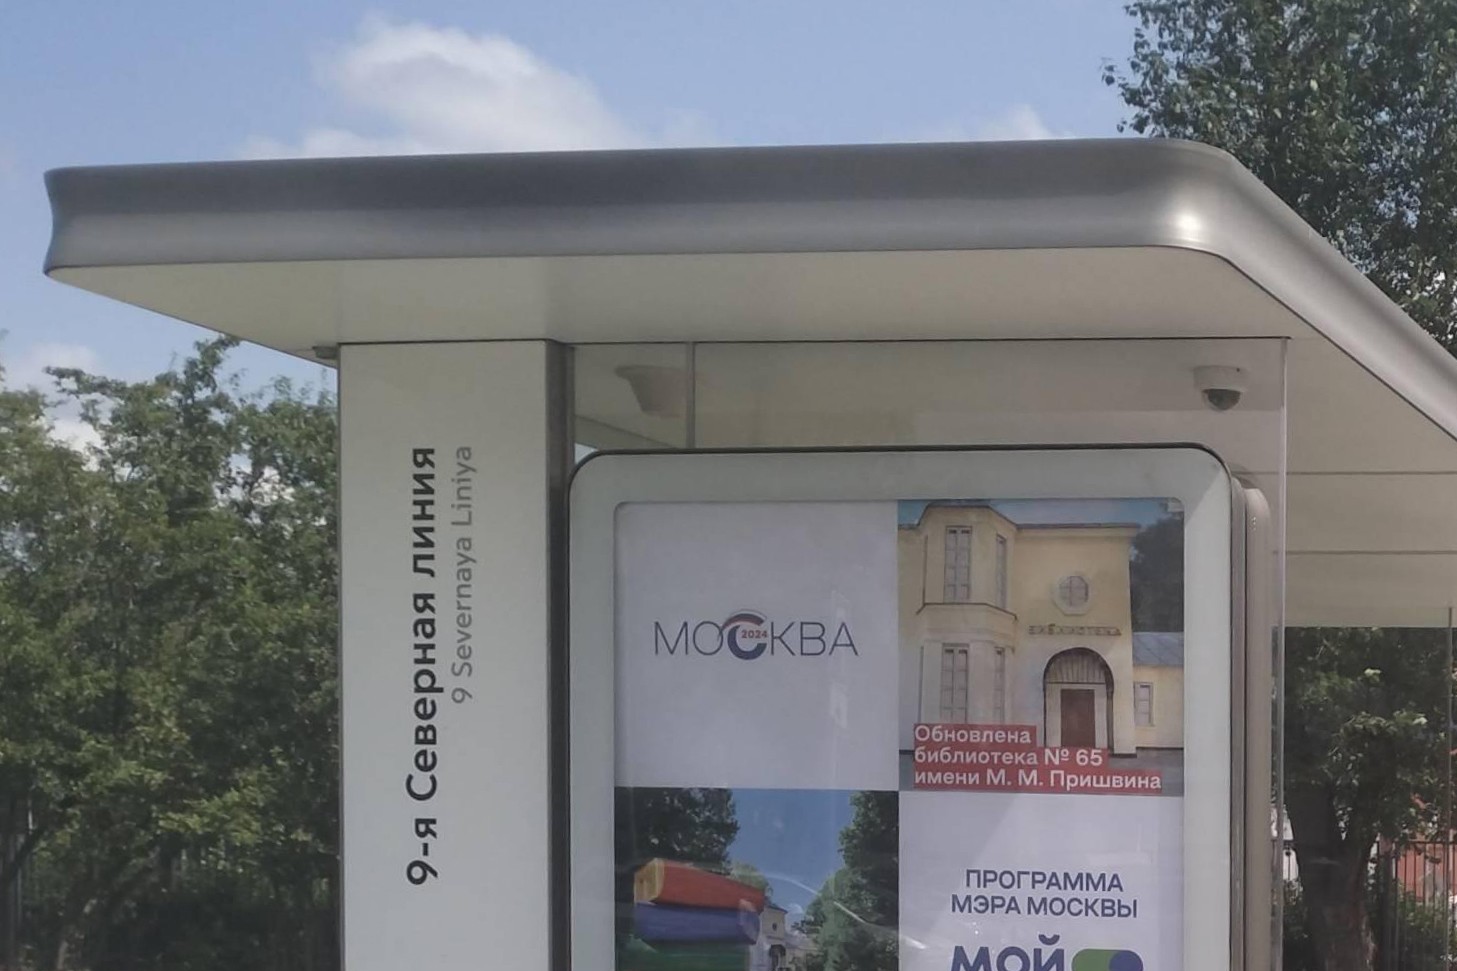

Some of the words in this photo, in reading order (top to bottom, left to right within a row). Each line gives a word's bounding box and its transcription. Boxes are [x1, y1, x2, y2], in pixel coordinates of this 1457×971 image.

[450, 446, 477, 526] Liniya
[412, 448, 436, 578] линия
[451, 537, 477, 677] Severnaya
[654, 609, 859, 661] МОСКВА
[741, 629, 768, 639] 2024
[405, 592, 444, 801] Северная
[451, 687, 473, 704] 9
[914, 725, 1031, 744] Обновлена
[914, 746, 1038, 765] библиотека
[1044, 749, 1070, 765] №
[1076, 750, 1103, 766] 65
[914, 769, 980, 786] имени
[986, 769, 1012, 787] М.
[1018, 770, 1044, 788] М.
[1050, 770, 1162, 791] Пришвина
[406, 818, 438, 885] 9-я
[965, 869, 1124, 892] ПРОГРАММА
[951, 894, 1021, 915] МЭРА
[1027, 896, 1138, 918] МОСКВЫ
